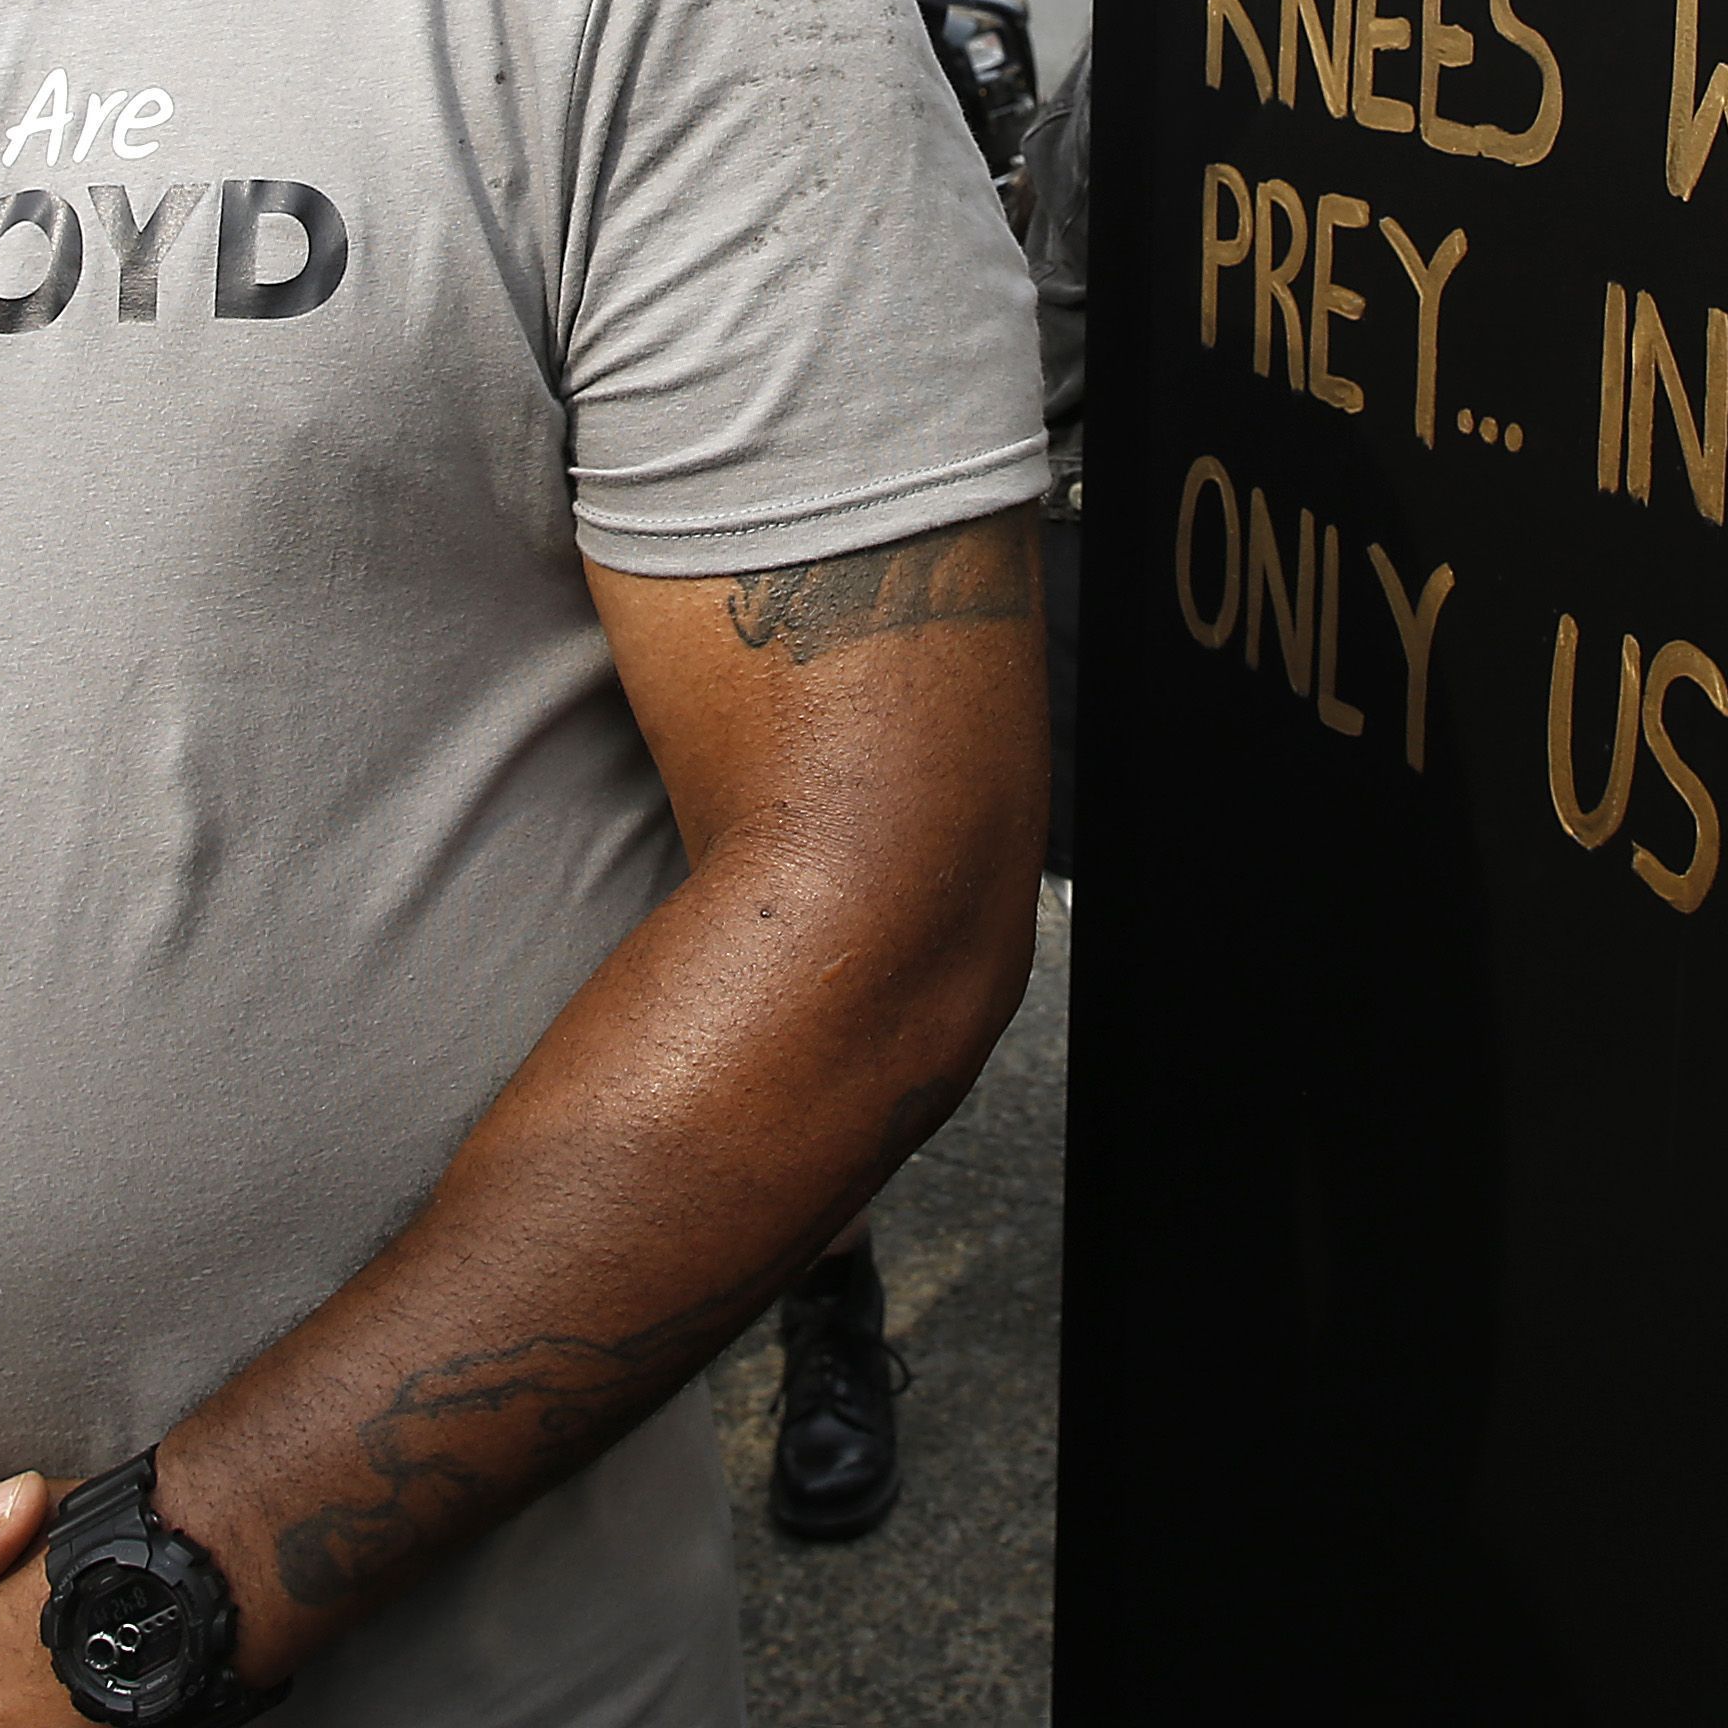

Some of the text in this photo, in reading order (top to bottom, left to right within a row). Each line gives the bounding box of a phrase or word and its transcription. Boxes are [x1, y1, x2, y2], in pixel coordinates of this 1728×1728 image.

[1, 67, 175, 163] Are
[1201, 162, 1524, 452] PREY...
[1175, 455, 1456, 774] ONLY
